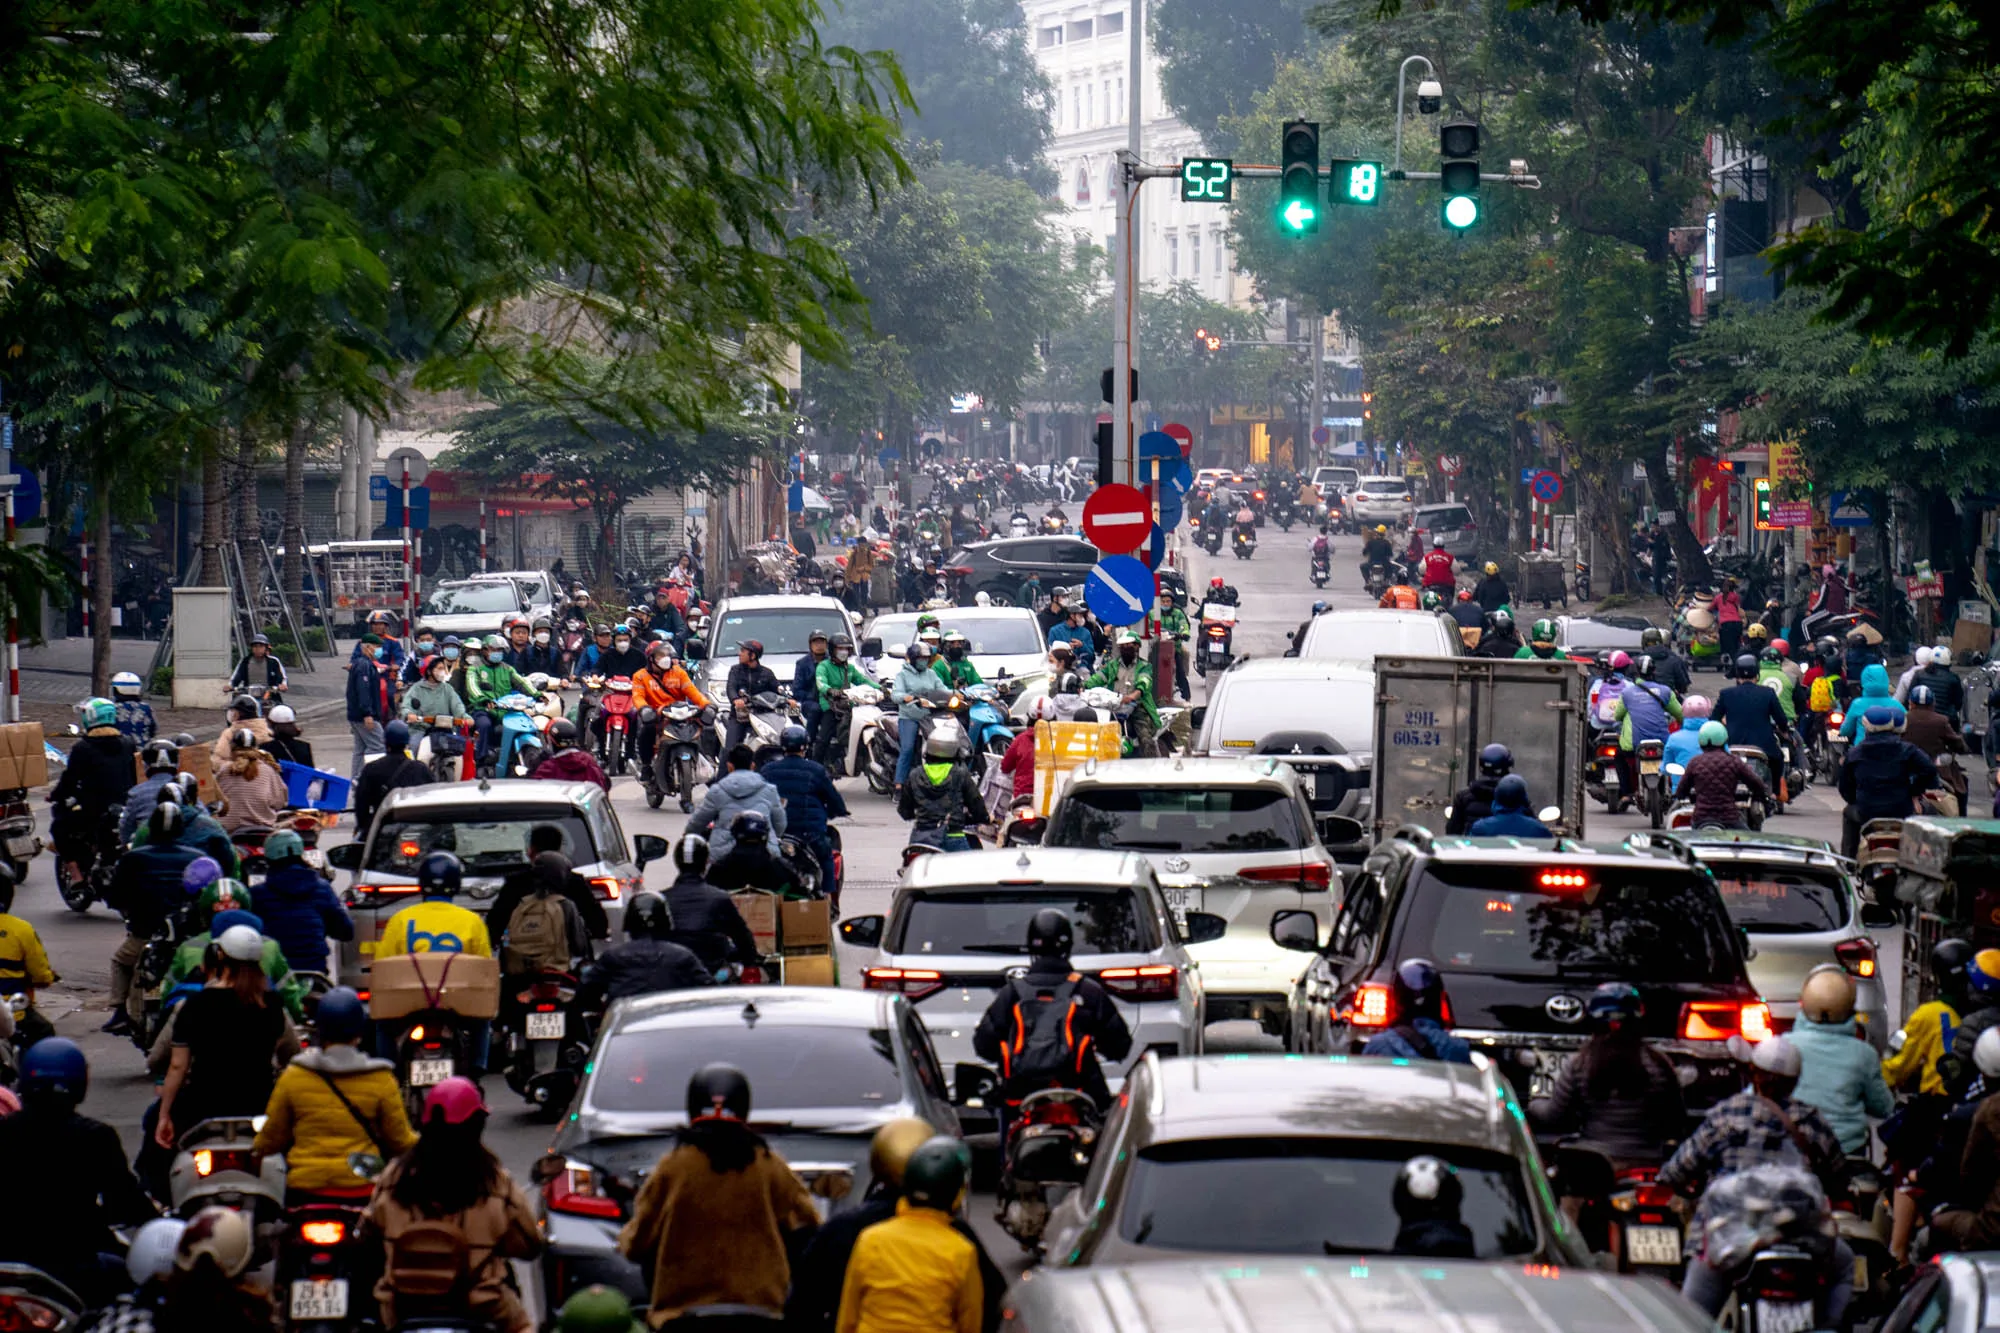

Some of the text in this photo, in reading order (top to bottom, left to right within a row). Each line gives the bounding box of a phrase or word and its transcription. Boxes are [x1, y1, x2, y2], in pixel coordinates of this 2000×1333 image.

[1185, 161, 1228, 197] 52
[1350, 163, 1377, 201] 18
[1393, 730, 1440, 746] 605.24
[1166, 889, 1190, 906] 30F
[407, 919, 463, 953] be
